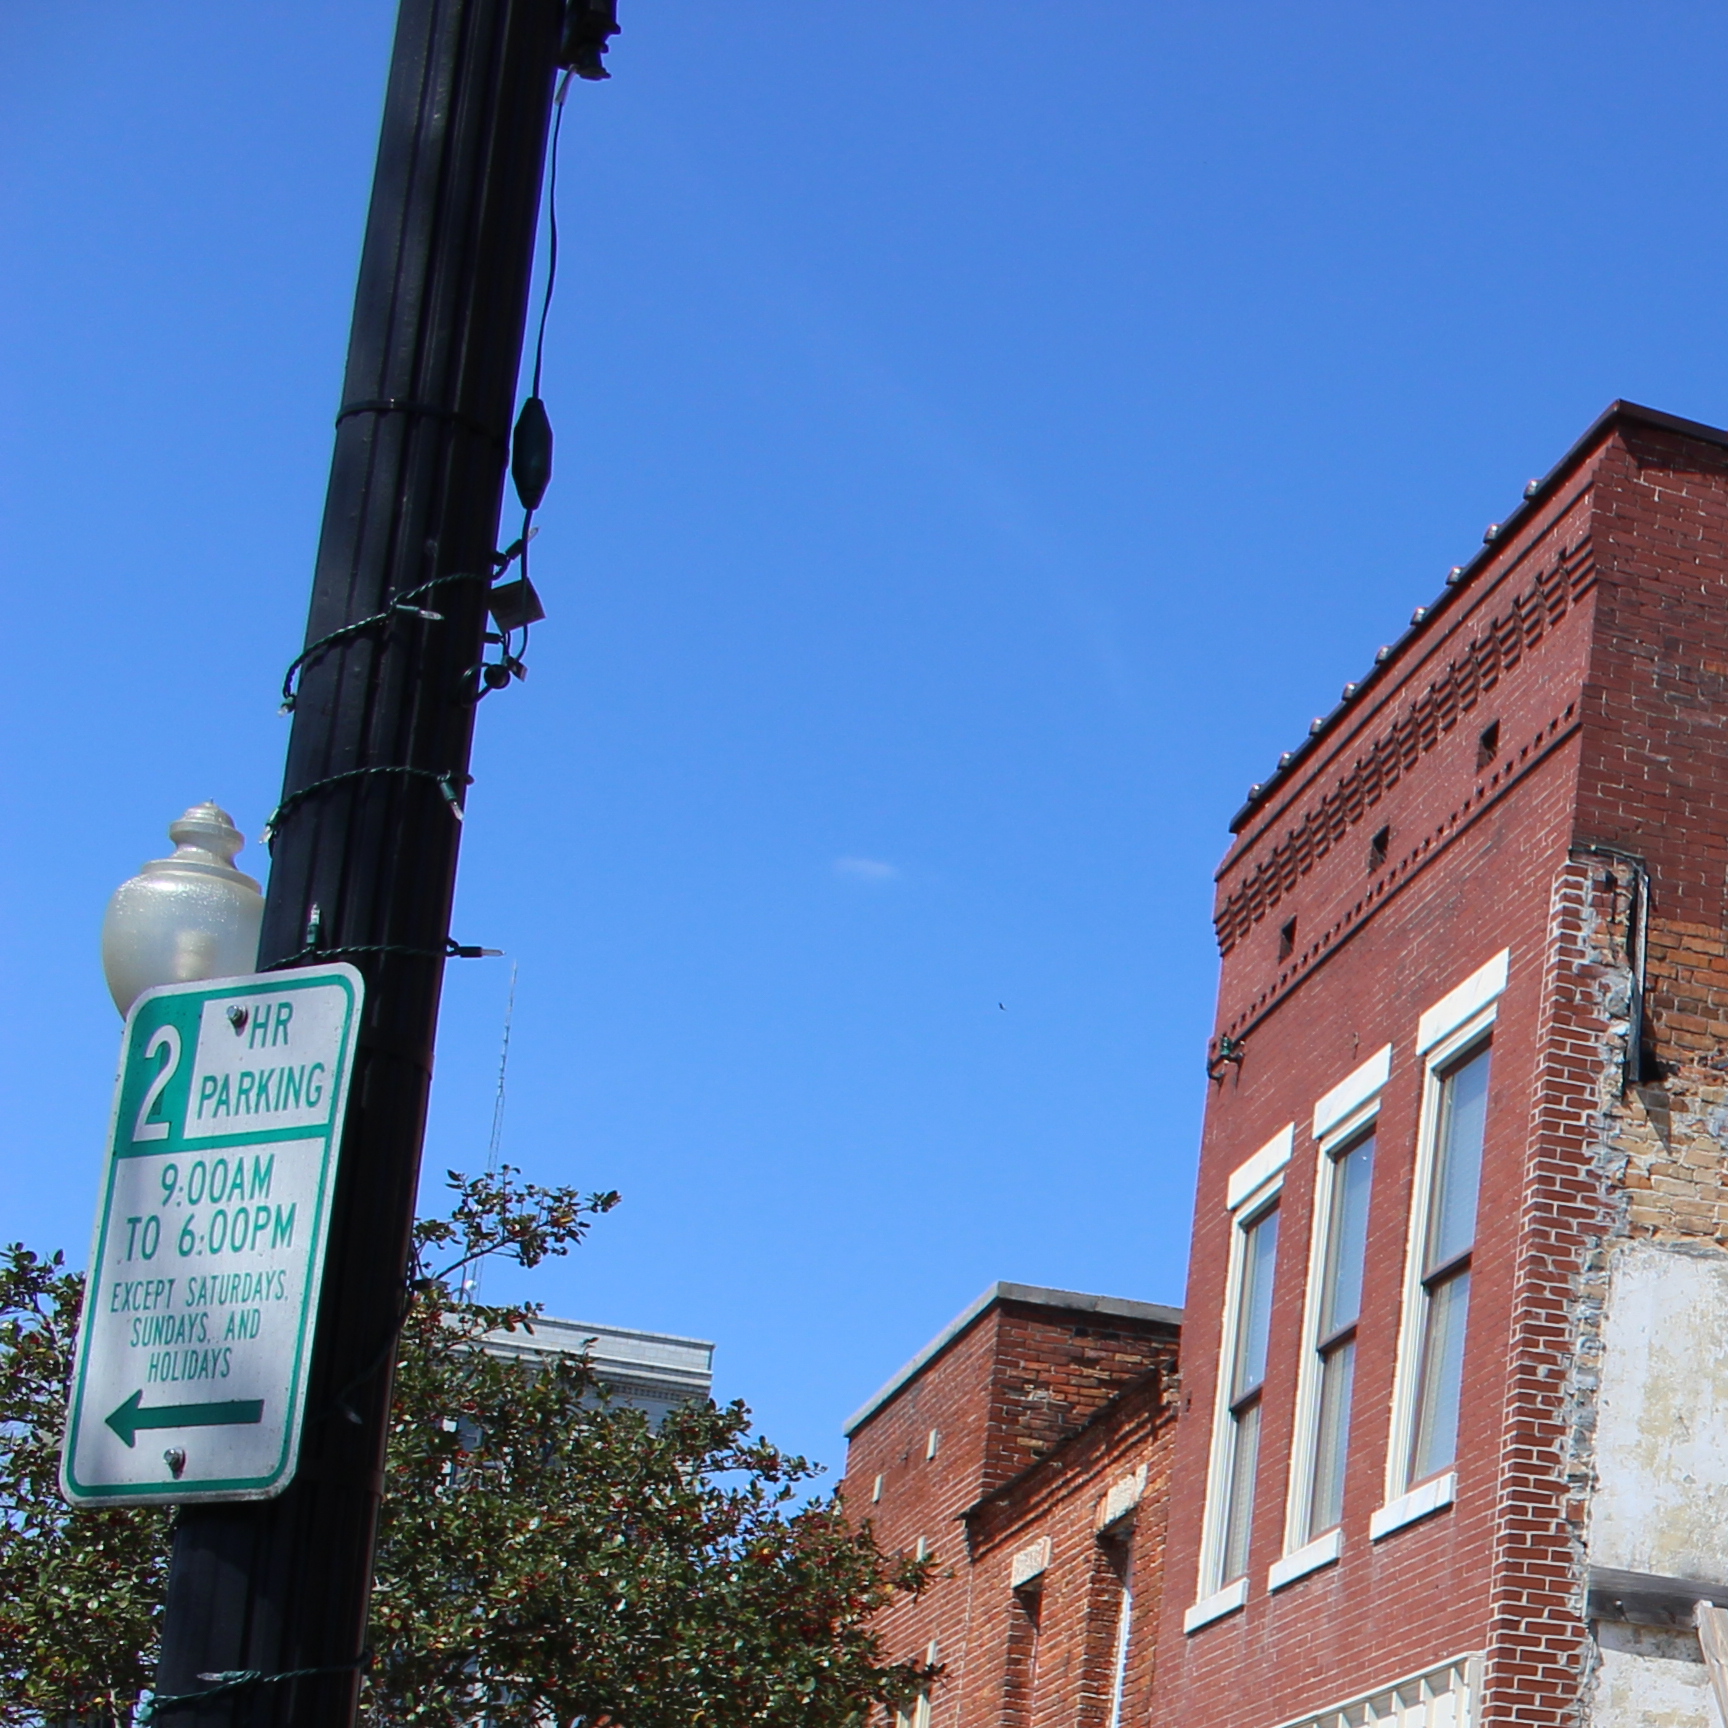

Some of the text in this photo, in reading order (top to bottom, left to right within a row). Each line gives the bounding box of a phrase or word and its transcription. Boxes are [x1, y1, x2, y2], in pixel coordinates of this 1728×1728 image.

[249, 1001, 294, 1050] HR
[132, 1023, 182, 1144] 2
[196, 1061, 325, 1120] PARKING
[161, 1153, 275, 1208] 9:00AM
[126, 1202, 297, 1262] TO 6:00PM
[110, 1277, 176, 1314] EXCEPT
[224, 1307, 262, 1342] AND
[146, 1346, 233, 1384] HOLIDAYS
